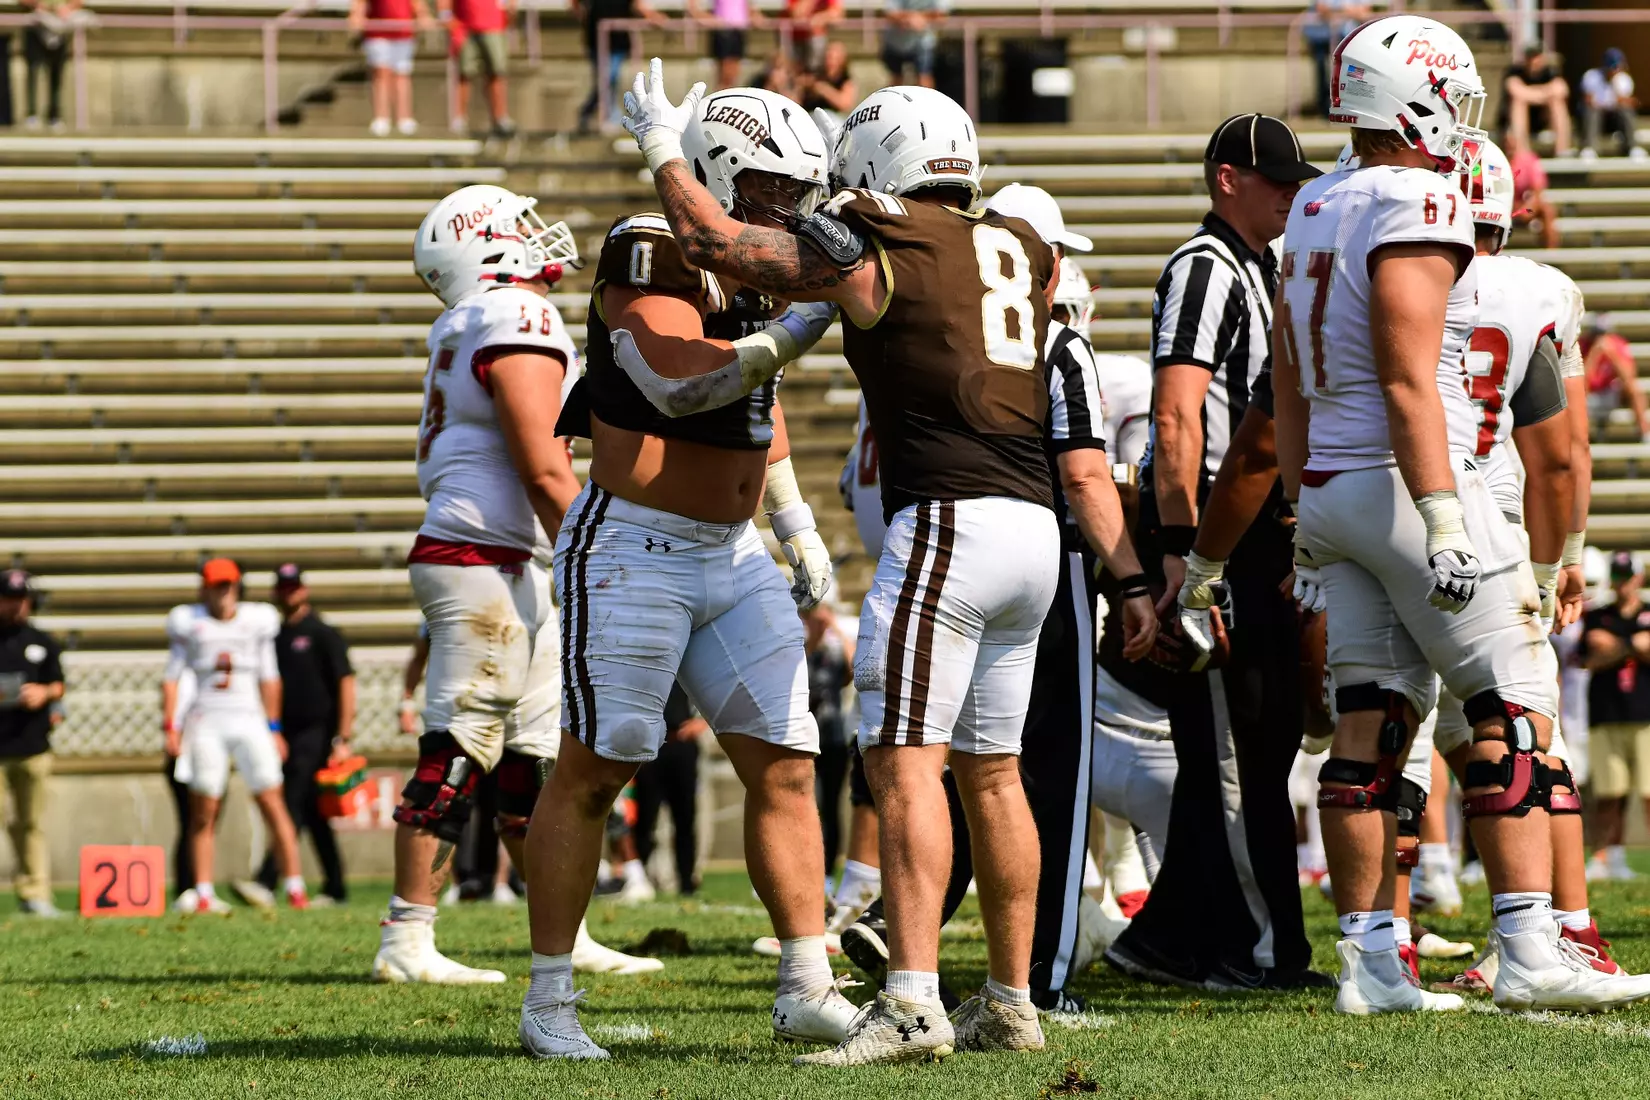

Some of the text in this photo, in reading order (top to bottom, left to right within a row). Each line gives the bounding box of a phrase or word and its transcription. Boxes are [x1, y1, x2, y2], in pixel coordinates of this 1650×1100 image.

[1406, 39, 1458, 70] Pios
[702, 106, 768, 148] LEHIGH
[843, 104, 882, 131] HIGH
[951, 139, 956, 152] 8
[934, 161, 949, 170] THE
[449, 203, 493, 242] Pios
[1424, 192, 1457, 227] 67
[629, 241, 654, 286] 0
[973, 223, 1038, 371] 8
[94, 860, 151, 908] 20
